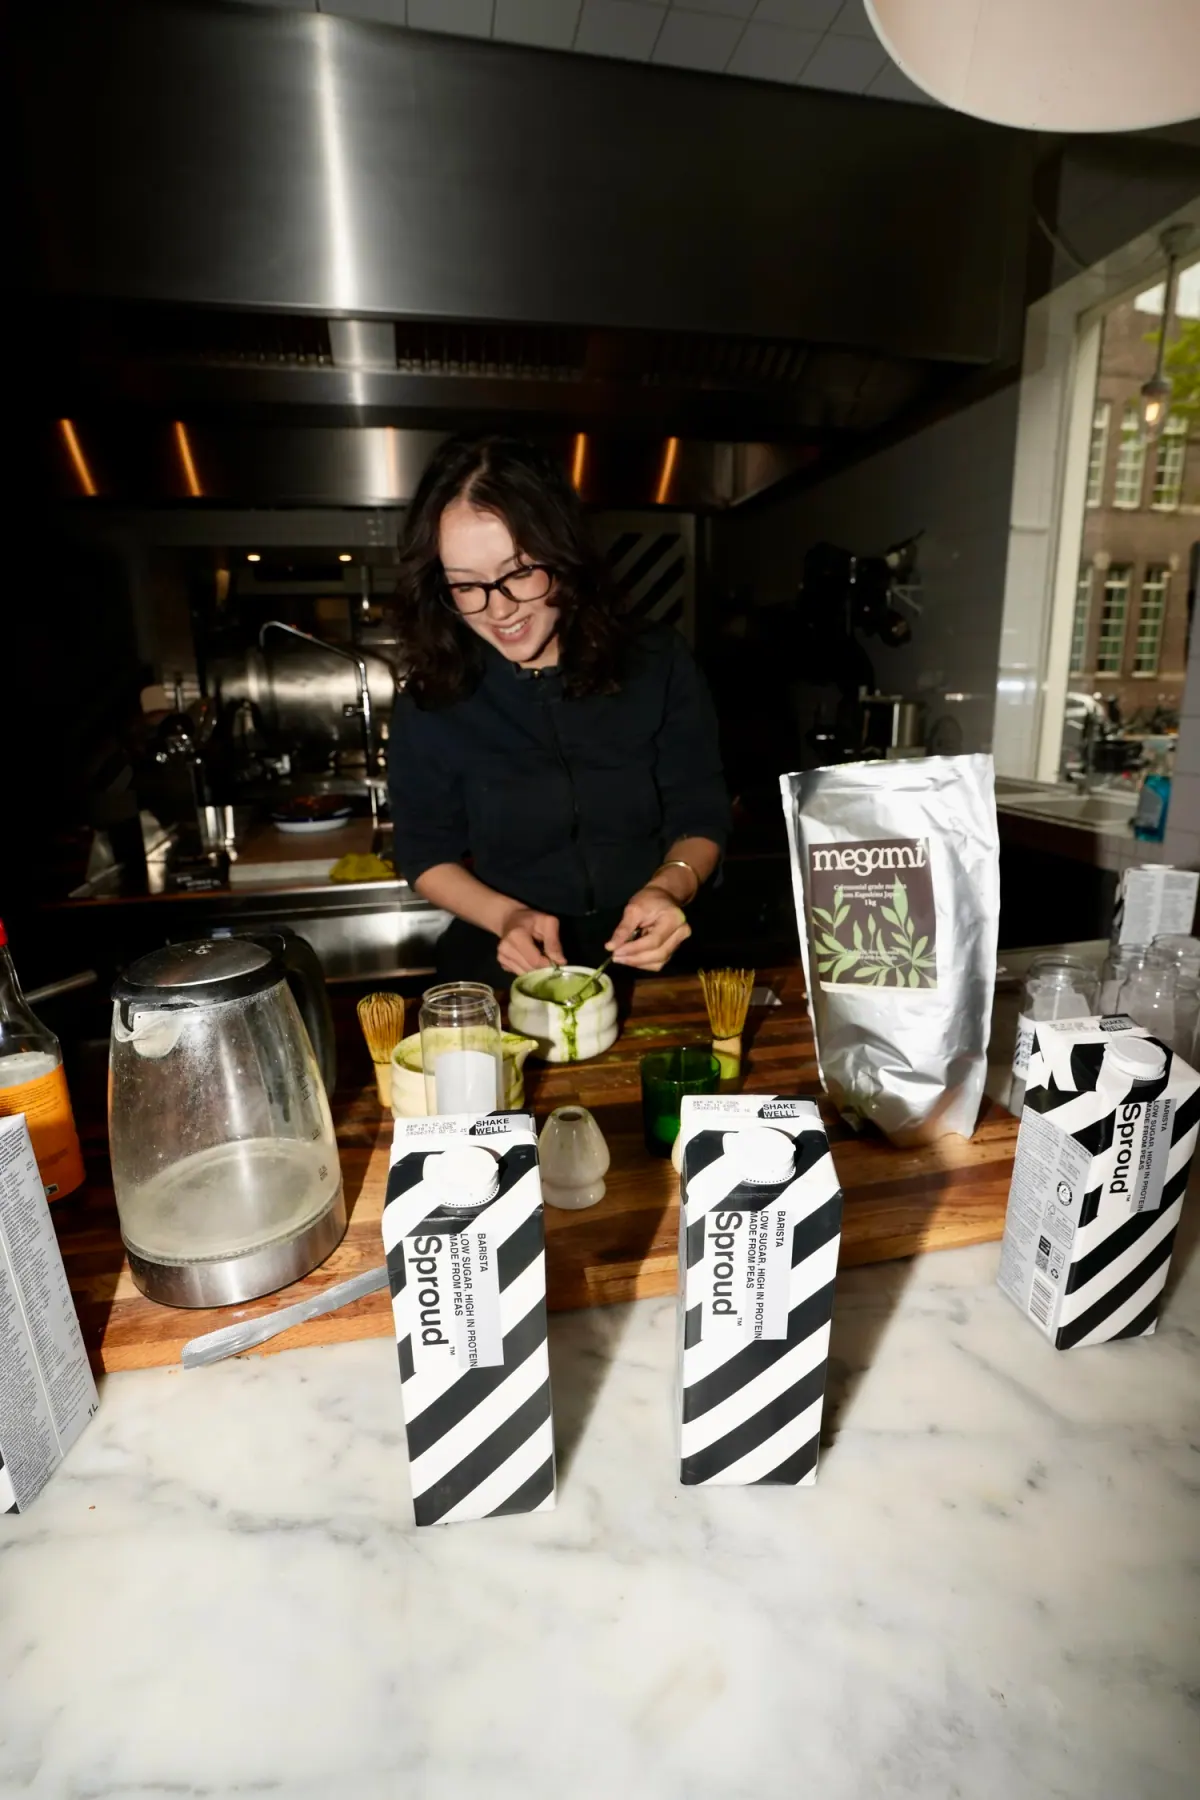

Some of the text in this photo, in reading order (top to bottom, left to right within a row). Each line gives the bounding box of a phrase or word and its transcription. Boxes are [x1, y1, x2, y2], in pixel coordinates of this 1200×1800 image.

[812, 842, 926, 876] megami
[867, 883, 884, 891] grade
[476, 1118, 509, 1127] SHAKE
[1152, 1100, 1160, 1118] LOW
[1161, 1099, 1171, 1132] BARISTA
[476, 1126, 507, 1135] WELL!
[1138, 1101, 1152, 1170] MADE FROM PEAS
[1109, 1104, 1141, 1194] Sproud
[1145, 1151, 1153, 1170] HIGH
[1143, 1171, 1150, 1180] IN
[1137, 1181, 1148, 1212] PROTEIN
[776, 1211, 785, 1247] BARISTA
[477, 1233, 488, 1272] BARISTA
[708, 1212, 743, 1315] Sproud
[746, 1211, 758, 1289] MADE FROM PEAS
[408, 1236, 449, 1346] Sproud
[449, 1233, 463, 1316] MADE FROM PEAS
[755, 1211, 768, 1339] LOW SUGAR, HIGH IN PROTEIN
[460, 1233, 478, 1367] LOW SUGAR, HIGH IN PROTEIN
